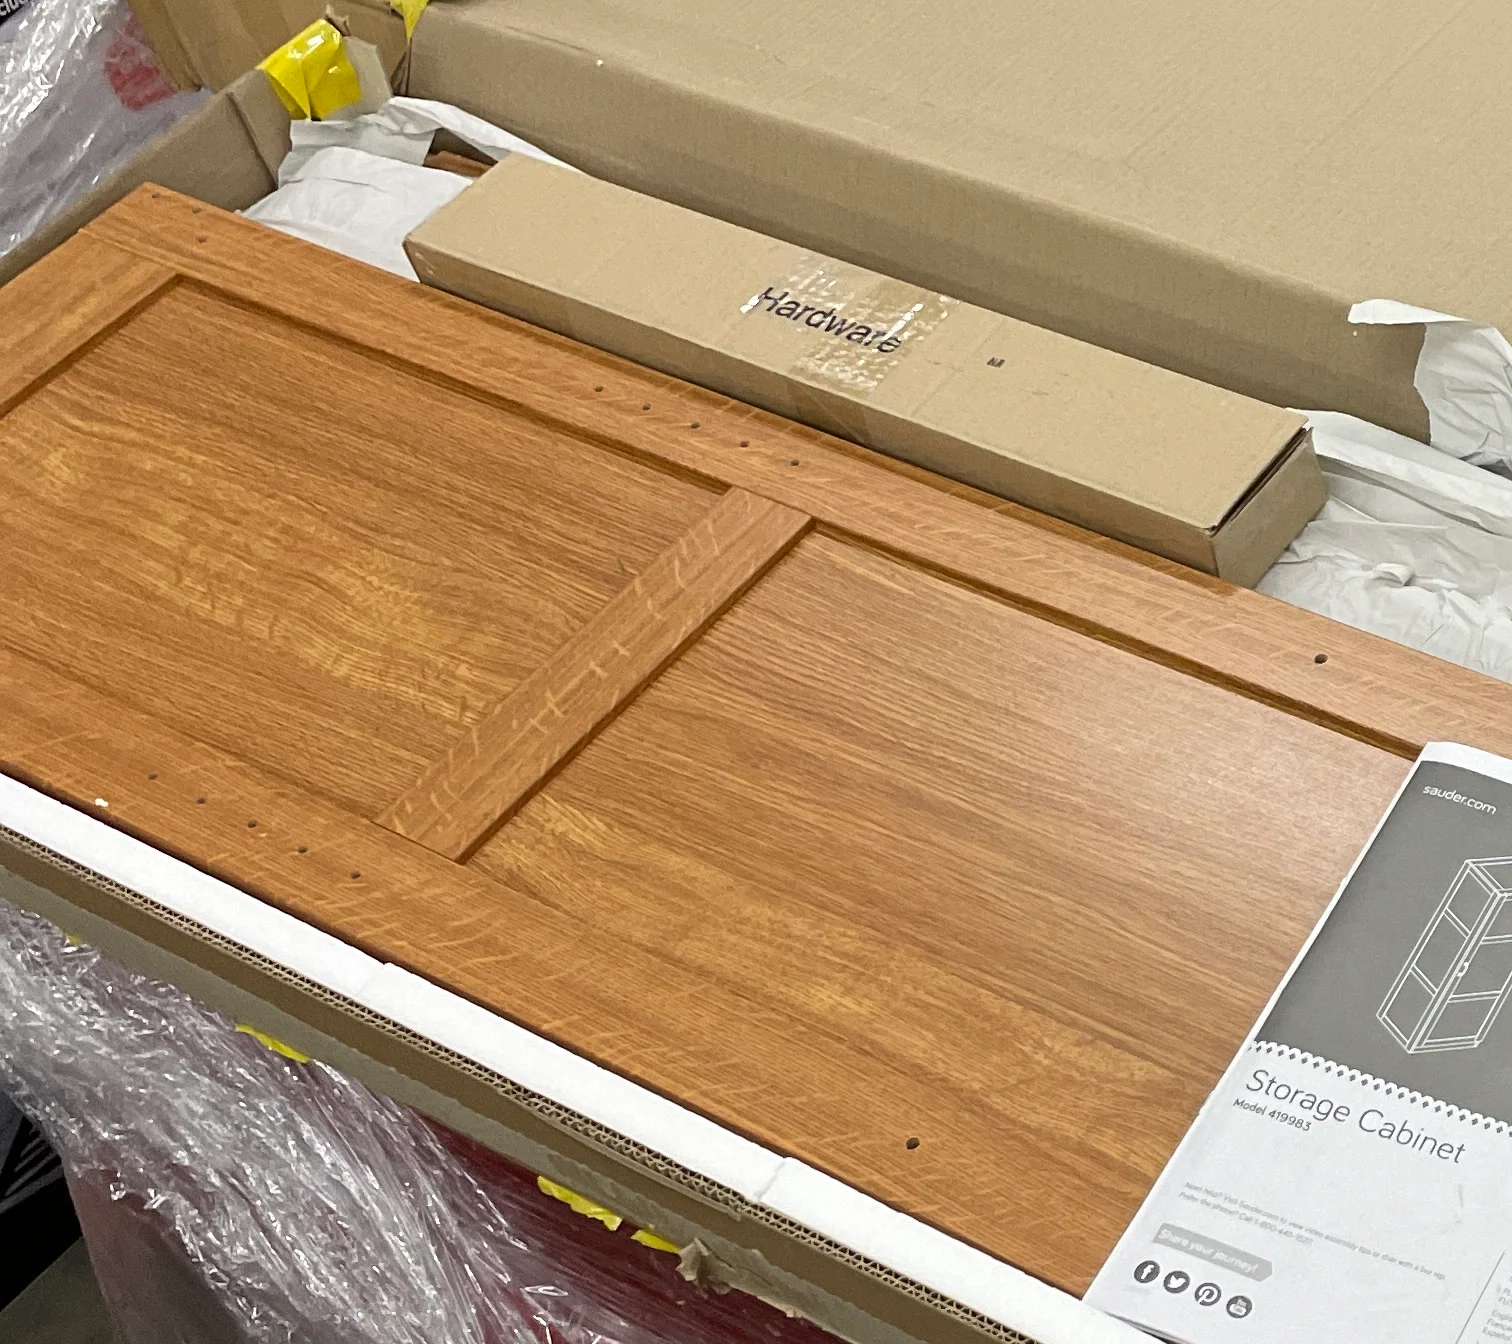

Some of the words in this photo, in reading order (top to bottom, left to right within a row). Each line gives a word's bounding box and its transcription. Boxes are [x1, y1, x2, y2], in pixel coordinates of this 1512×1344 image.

[751, 286, 902, 353] Hardware
[1423, 786, 1497, 814] sauder.com
[1233, 1098, 1267, 1116] Model
[1268, 1109, 1312, 1132] 419983
[1246, 1069, 1350, 1123] Storage
[1359, 1108, 1466, 1164] Cabinet
[1158, 1228, 1189, 1247] Share
[1189, 1241, 1213, 1255] your
